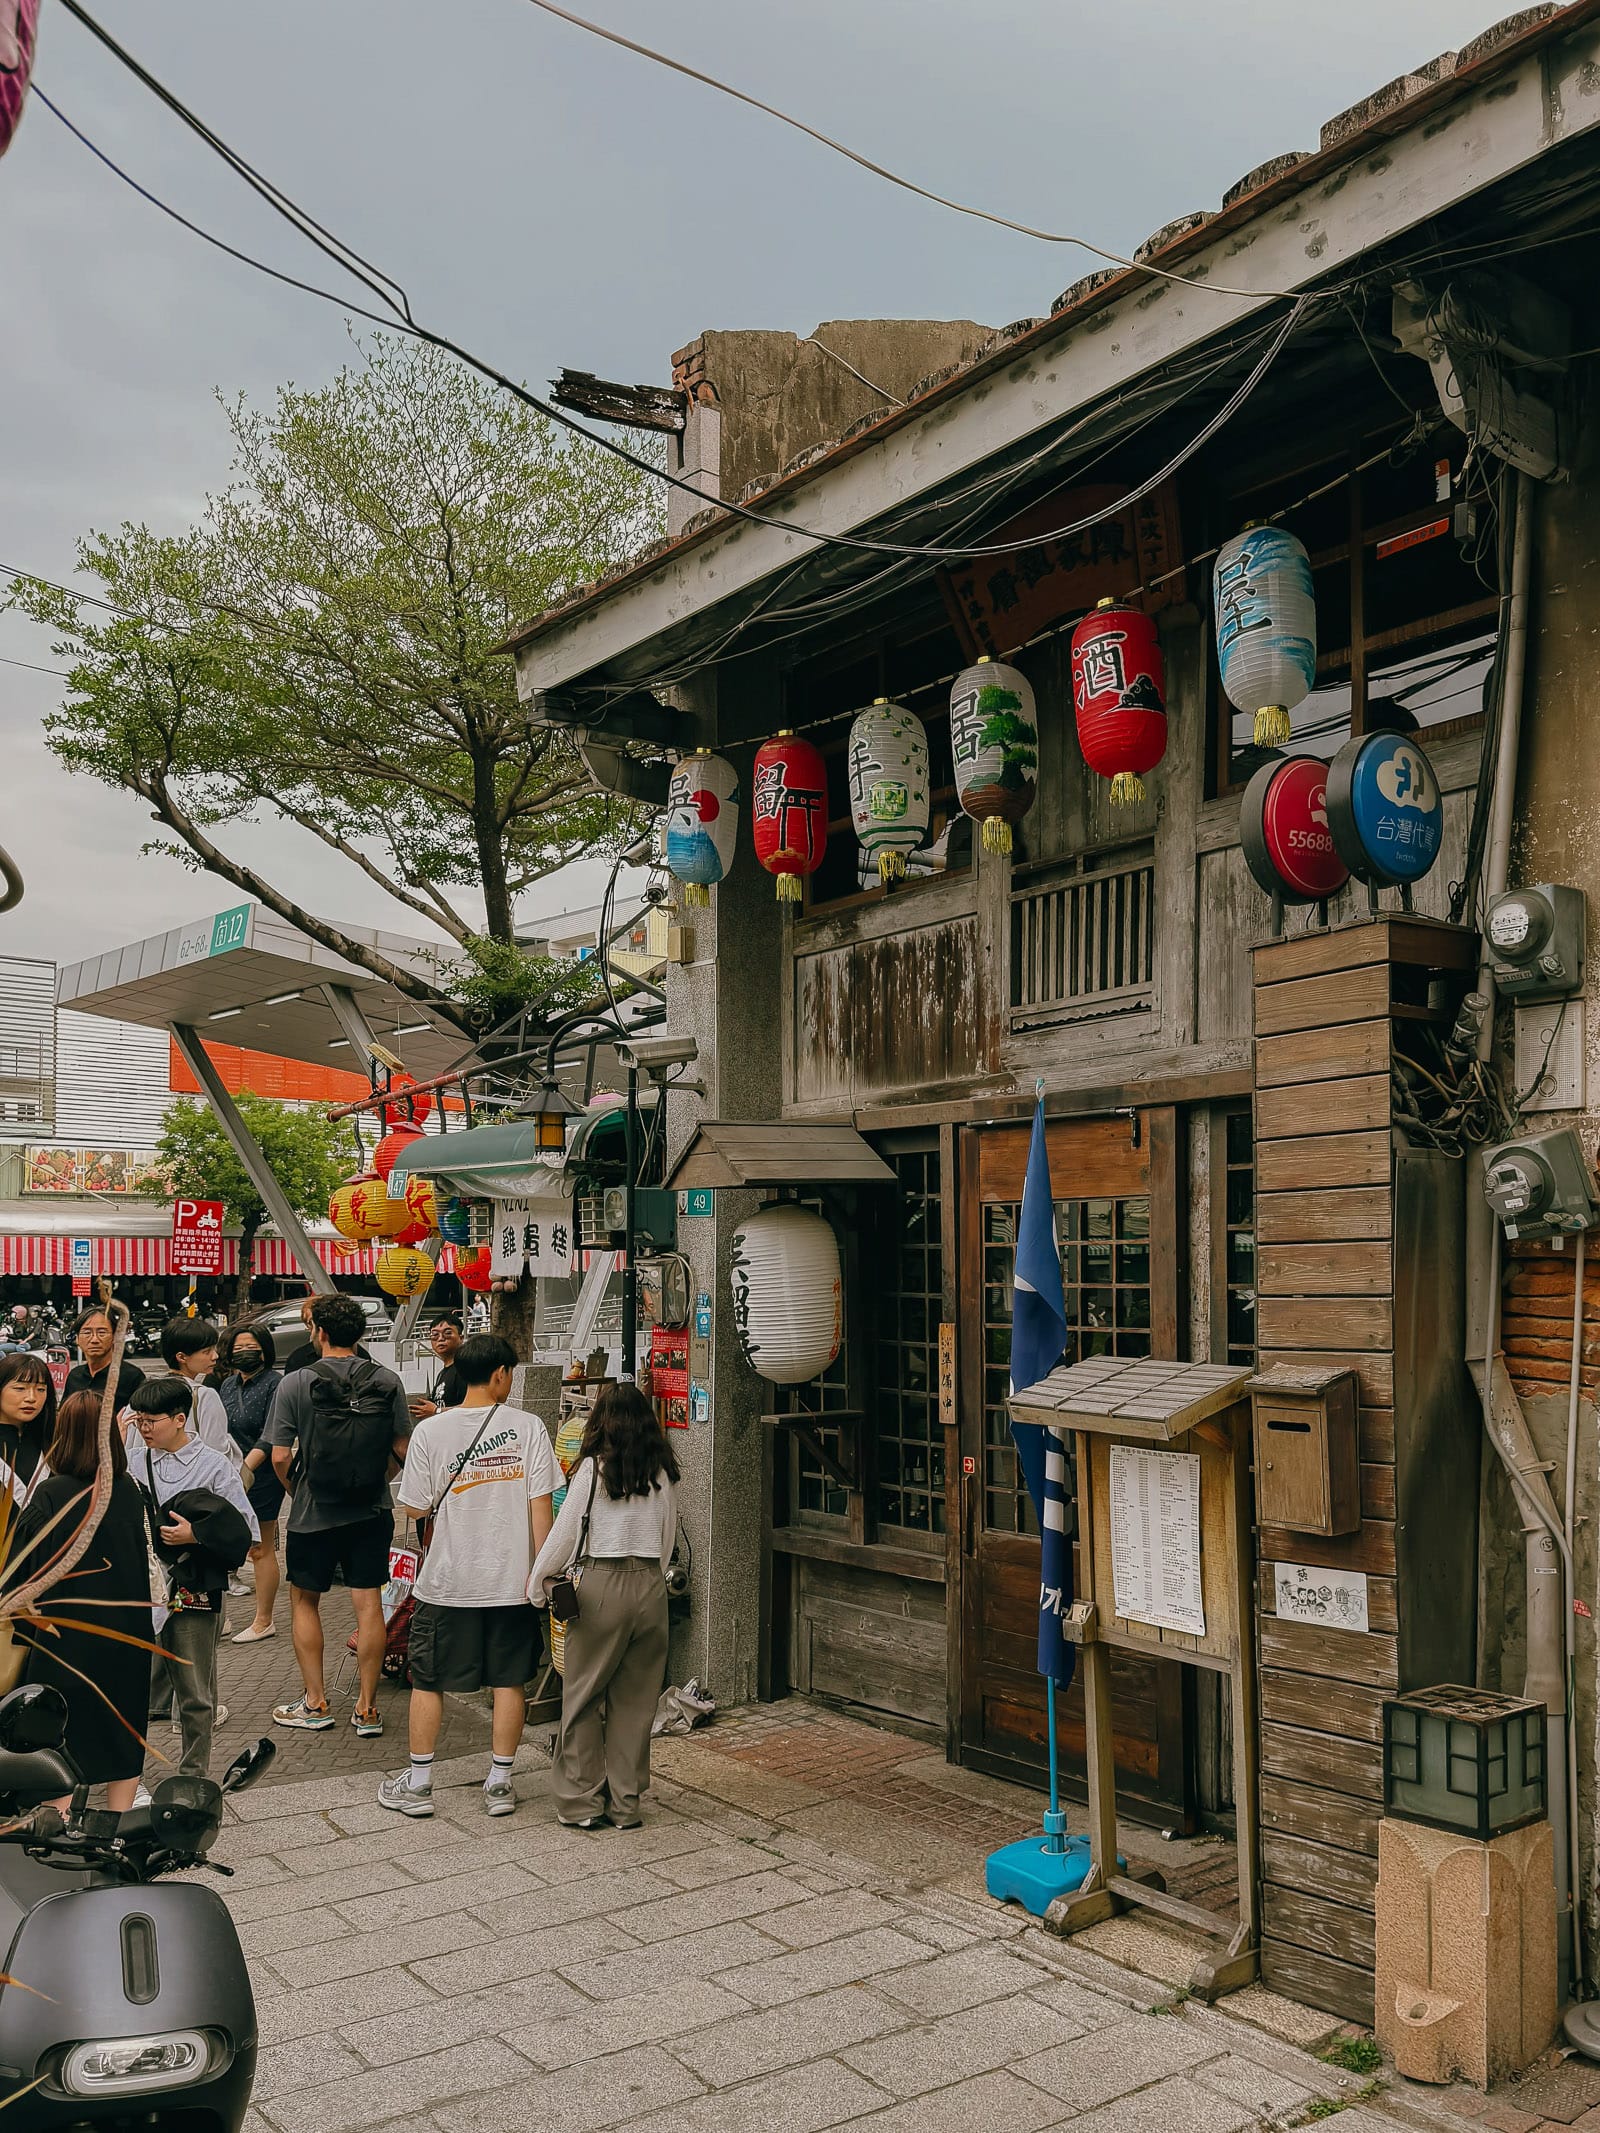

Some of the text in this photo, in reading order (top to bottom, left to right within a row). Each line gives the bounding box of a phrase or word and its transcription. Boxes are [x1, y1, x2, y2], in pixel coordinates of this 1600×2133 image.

[1217, 553, 1272, 648] 屋
[1073, 630, 1128, 709] 酒
[952, 686, 988, 768] 居
[754, 761, 788, 822] 留
[1287, 829, 1333, 852] 55688
[228, 913, 244, 944] 12
[393, 1180, 404, 1194] 47
[693, 1194, 706, 1209] 49
[177, 1201, 197, 1226] P
[502, 1222, 567, 1259] 雞蛋糕
